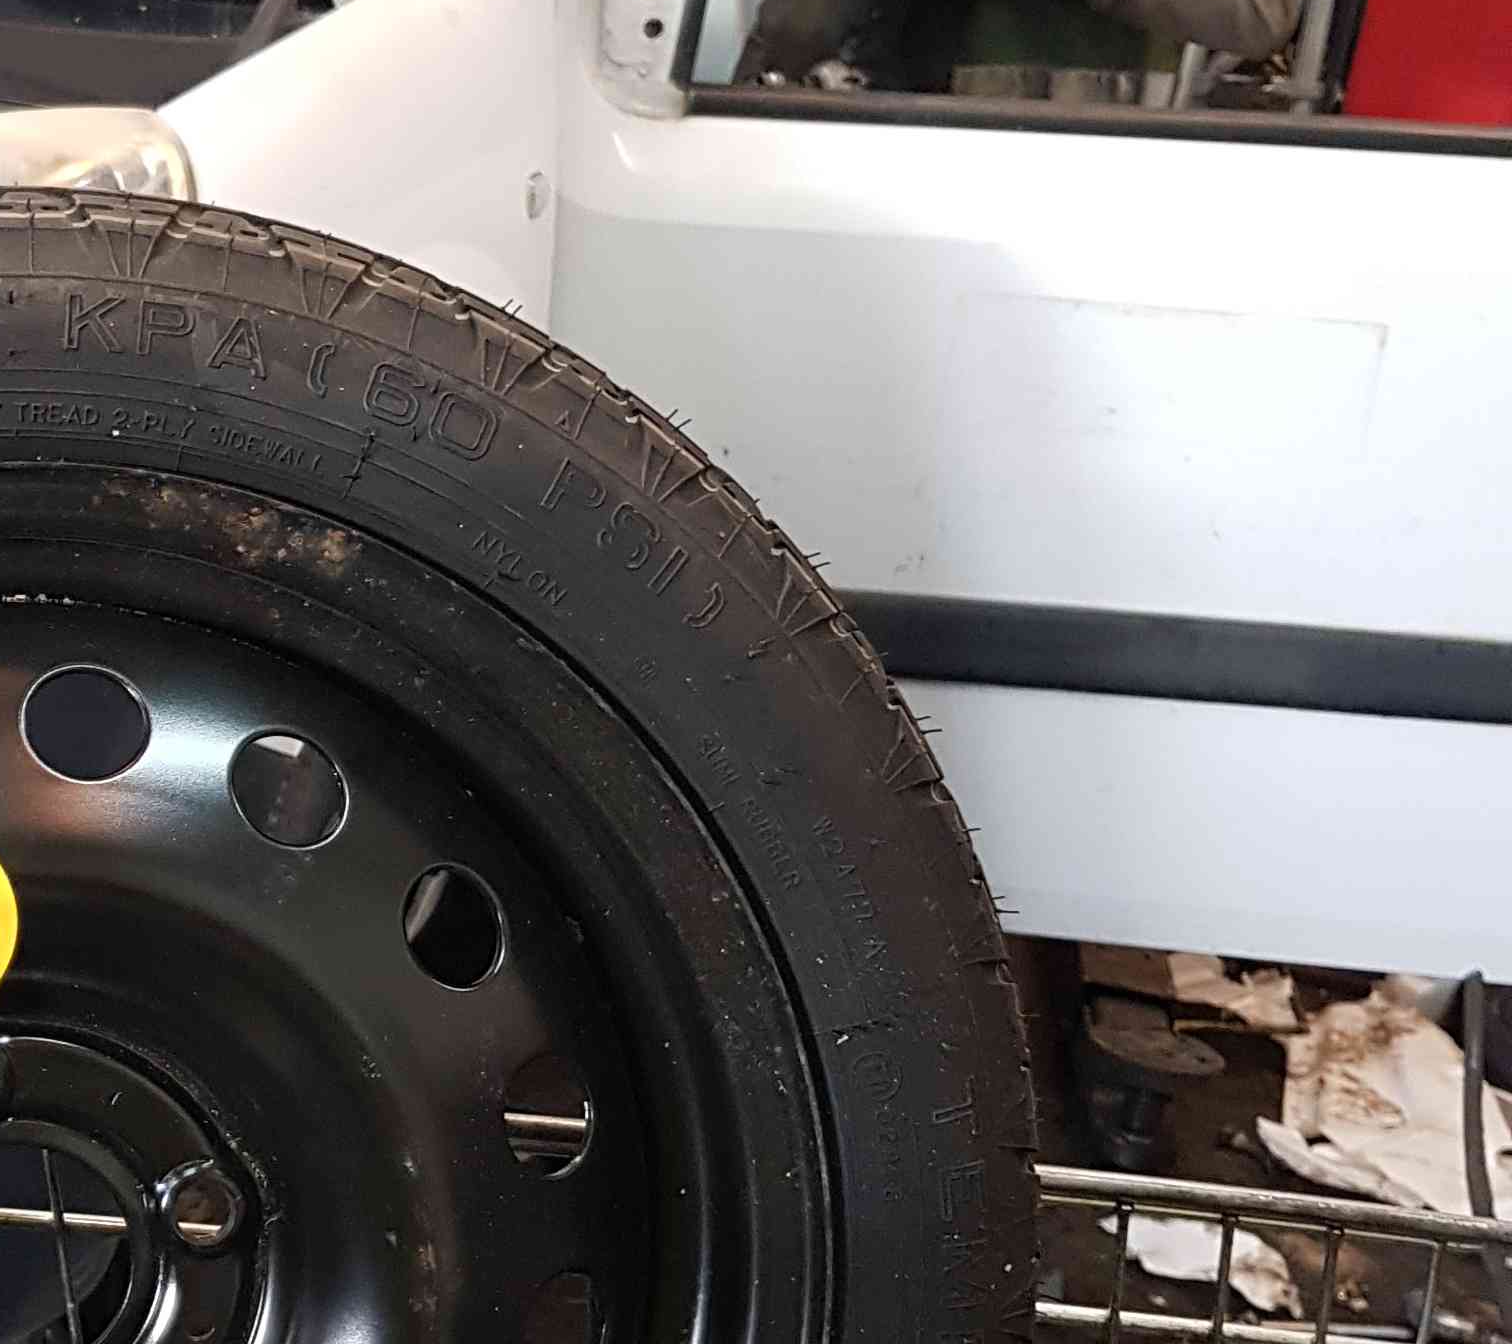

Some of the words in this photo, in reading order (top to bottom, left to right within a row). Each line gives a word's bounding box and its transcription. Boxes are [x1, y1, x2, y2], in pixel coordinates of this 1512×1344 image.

[63, 292, 266, 379] KPA
[14, 401, 101, 427] TREAD
[112, 406, 196, 440] 2-PLY
[471, 529, 570, 608] NYLON
